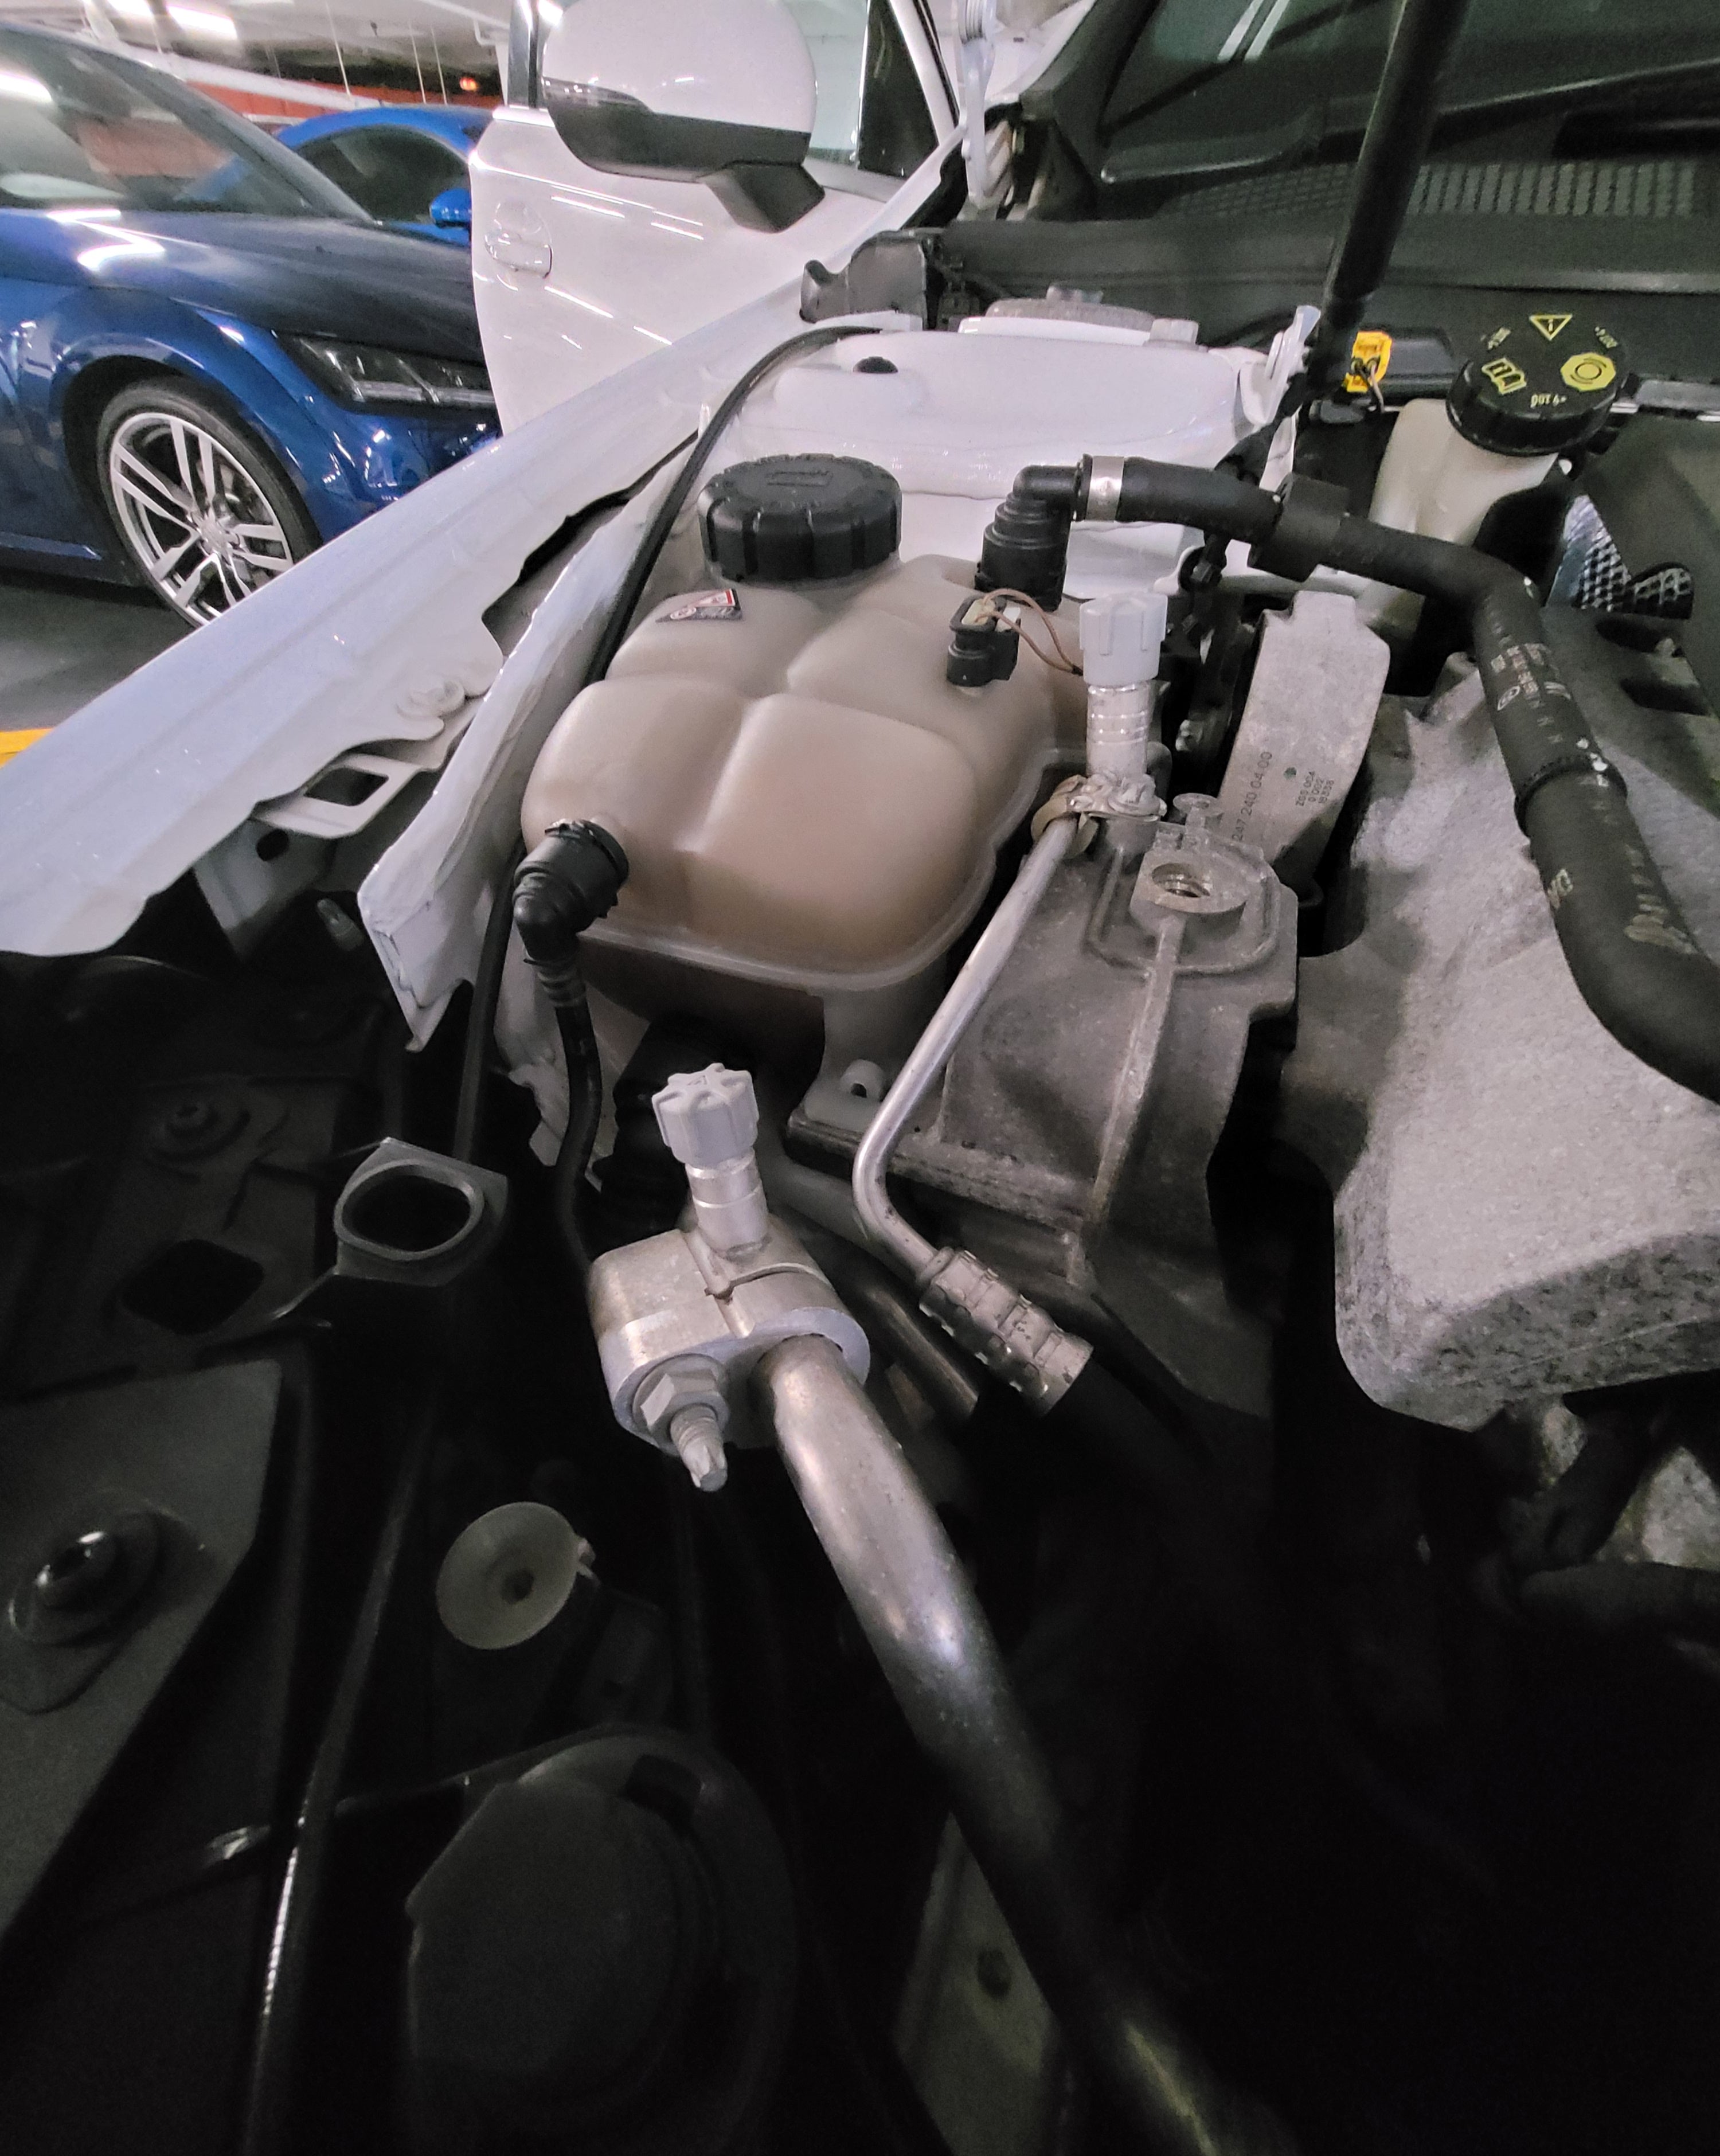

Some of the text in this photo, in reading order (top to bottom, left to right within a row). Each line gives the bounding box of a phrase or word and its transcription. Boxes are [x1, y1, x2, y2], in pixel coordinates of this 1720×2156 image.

[1232, 751, 1273, 842] 247 240 04 00
